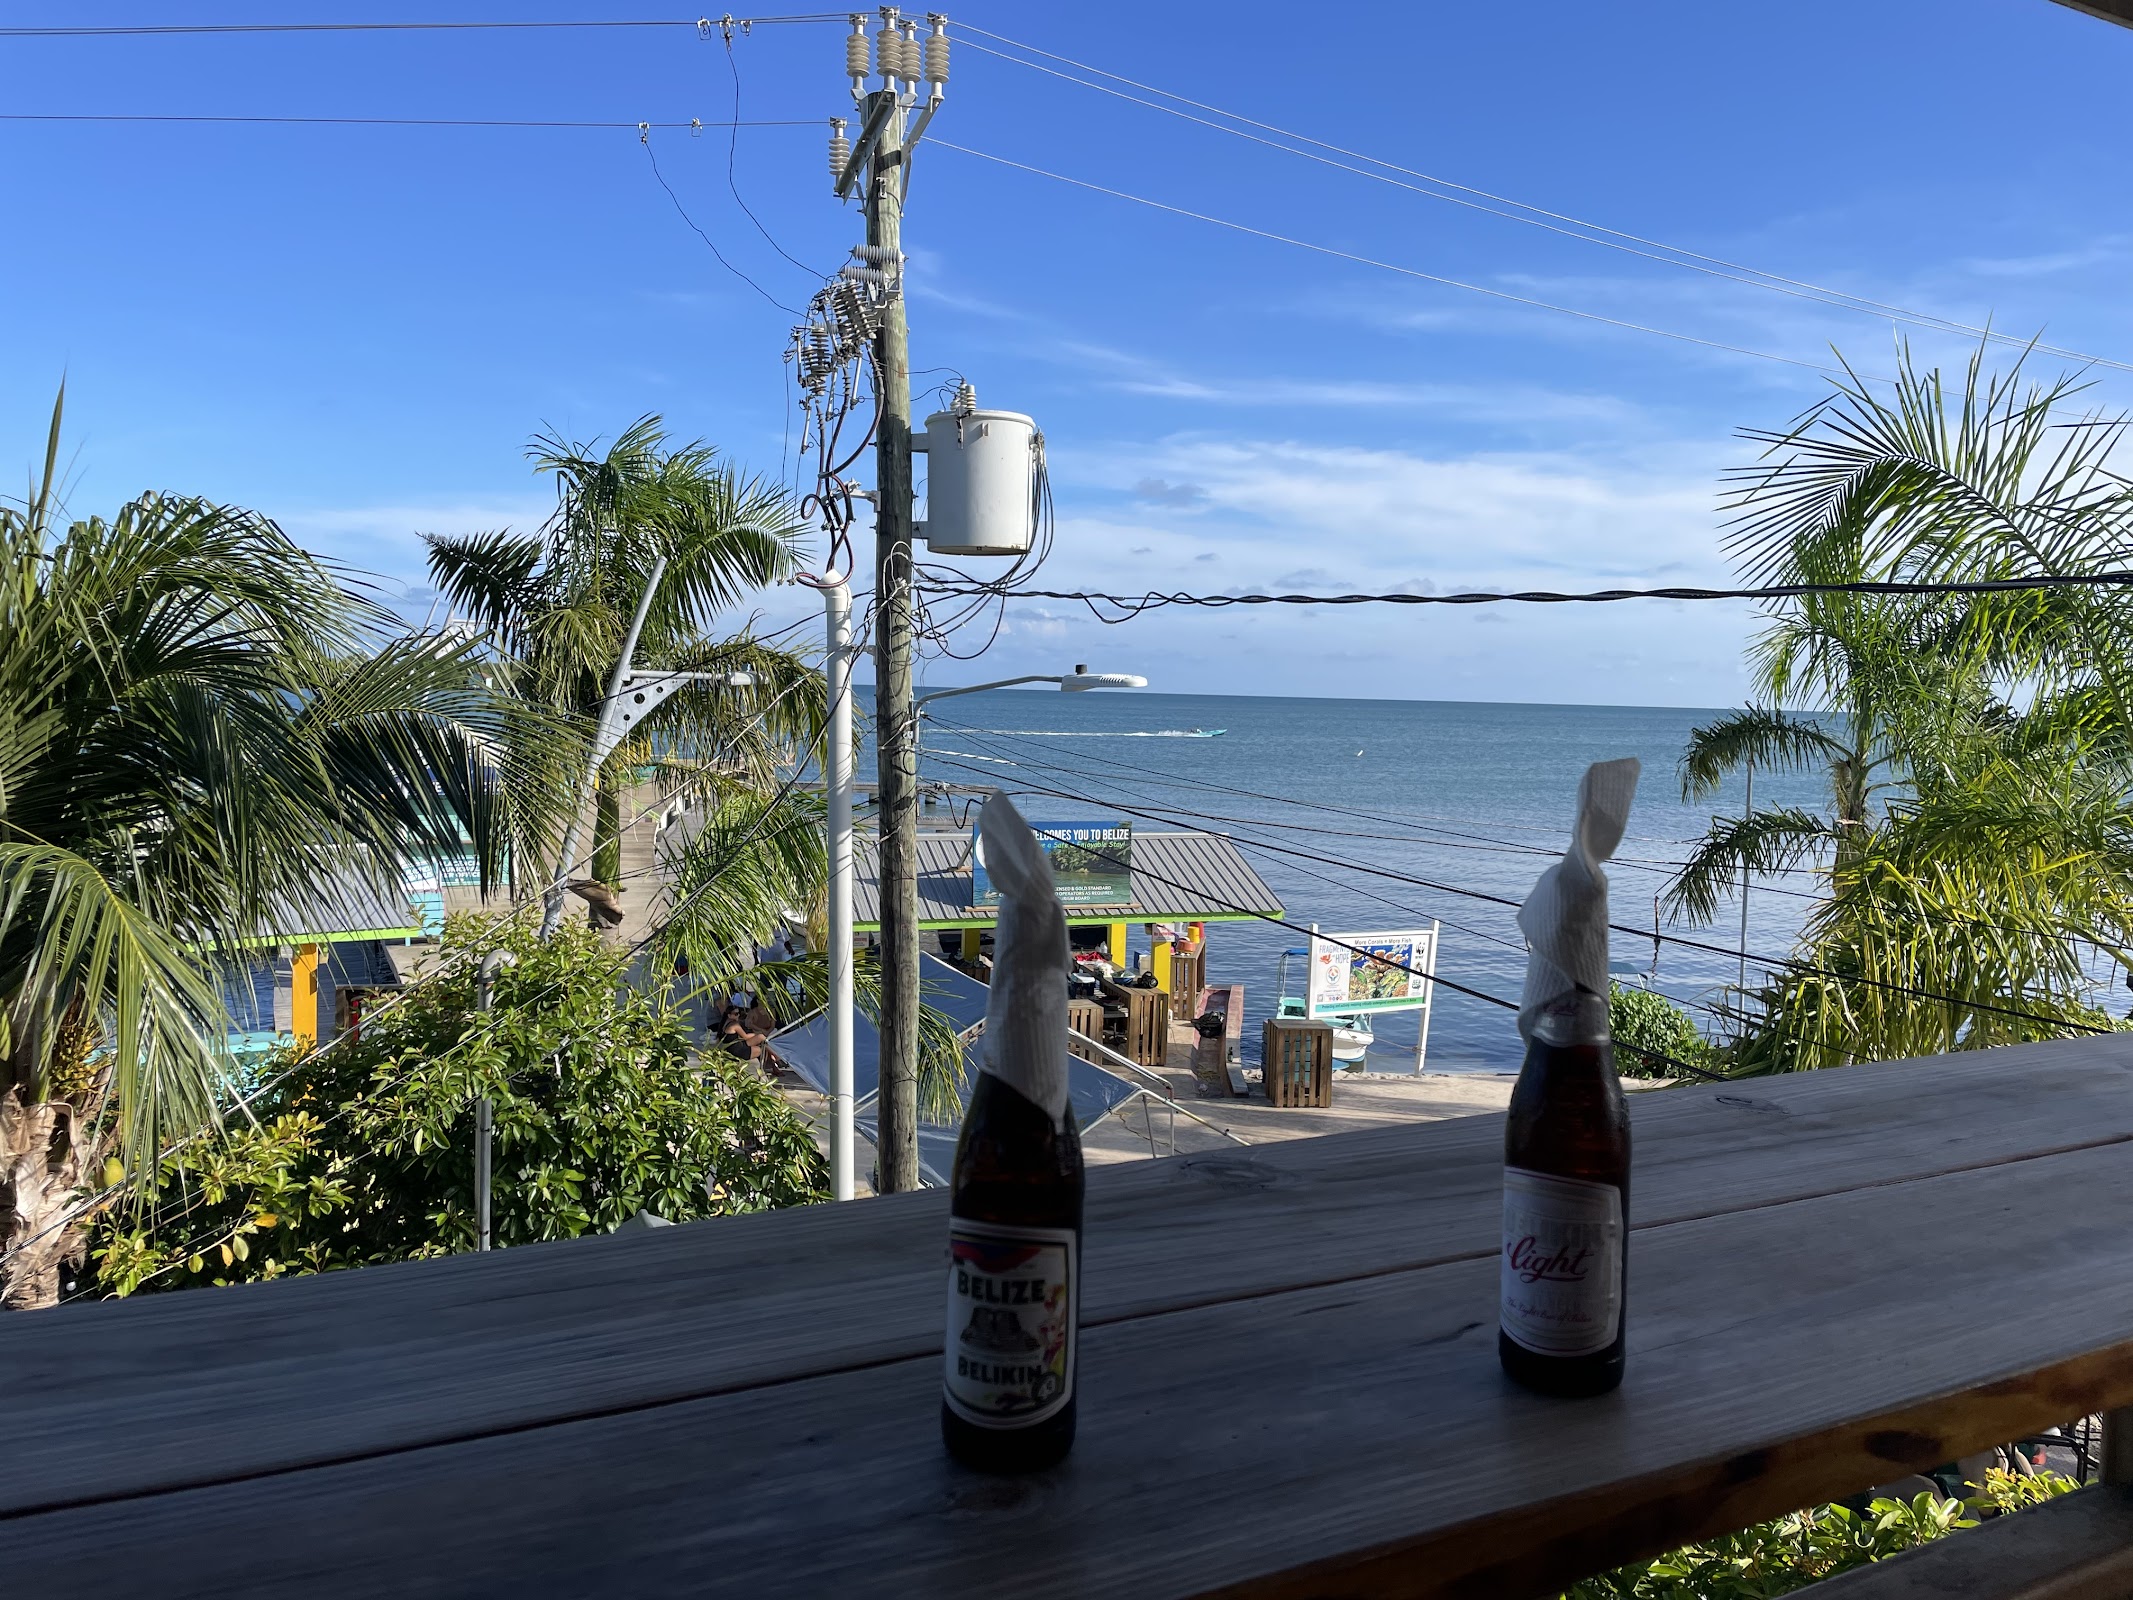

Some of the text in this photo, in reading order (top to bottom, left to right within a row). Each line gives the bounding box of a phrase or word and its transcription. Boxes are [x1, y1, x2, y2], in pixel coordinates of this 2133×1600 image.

[1073, 828, 1088, 840] YOU
[1091, 828, 1100, 840] TO
[1102, 828, 1129, 840] BELIZE
[1053, 841, 1068, 849] Safe
[1077, 841, 1107, 851] Enjoyable
[1108, 841, 1126, 849] Stay!
[1335, 953, 1349, 963] HOPE
[1506, 1236, 1595, 1284] Light
[956, 1270, 1046, 1305] BELIZE
[957, 1353, 1042, 1385] BELIKIN
